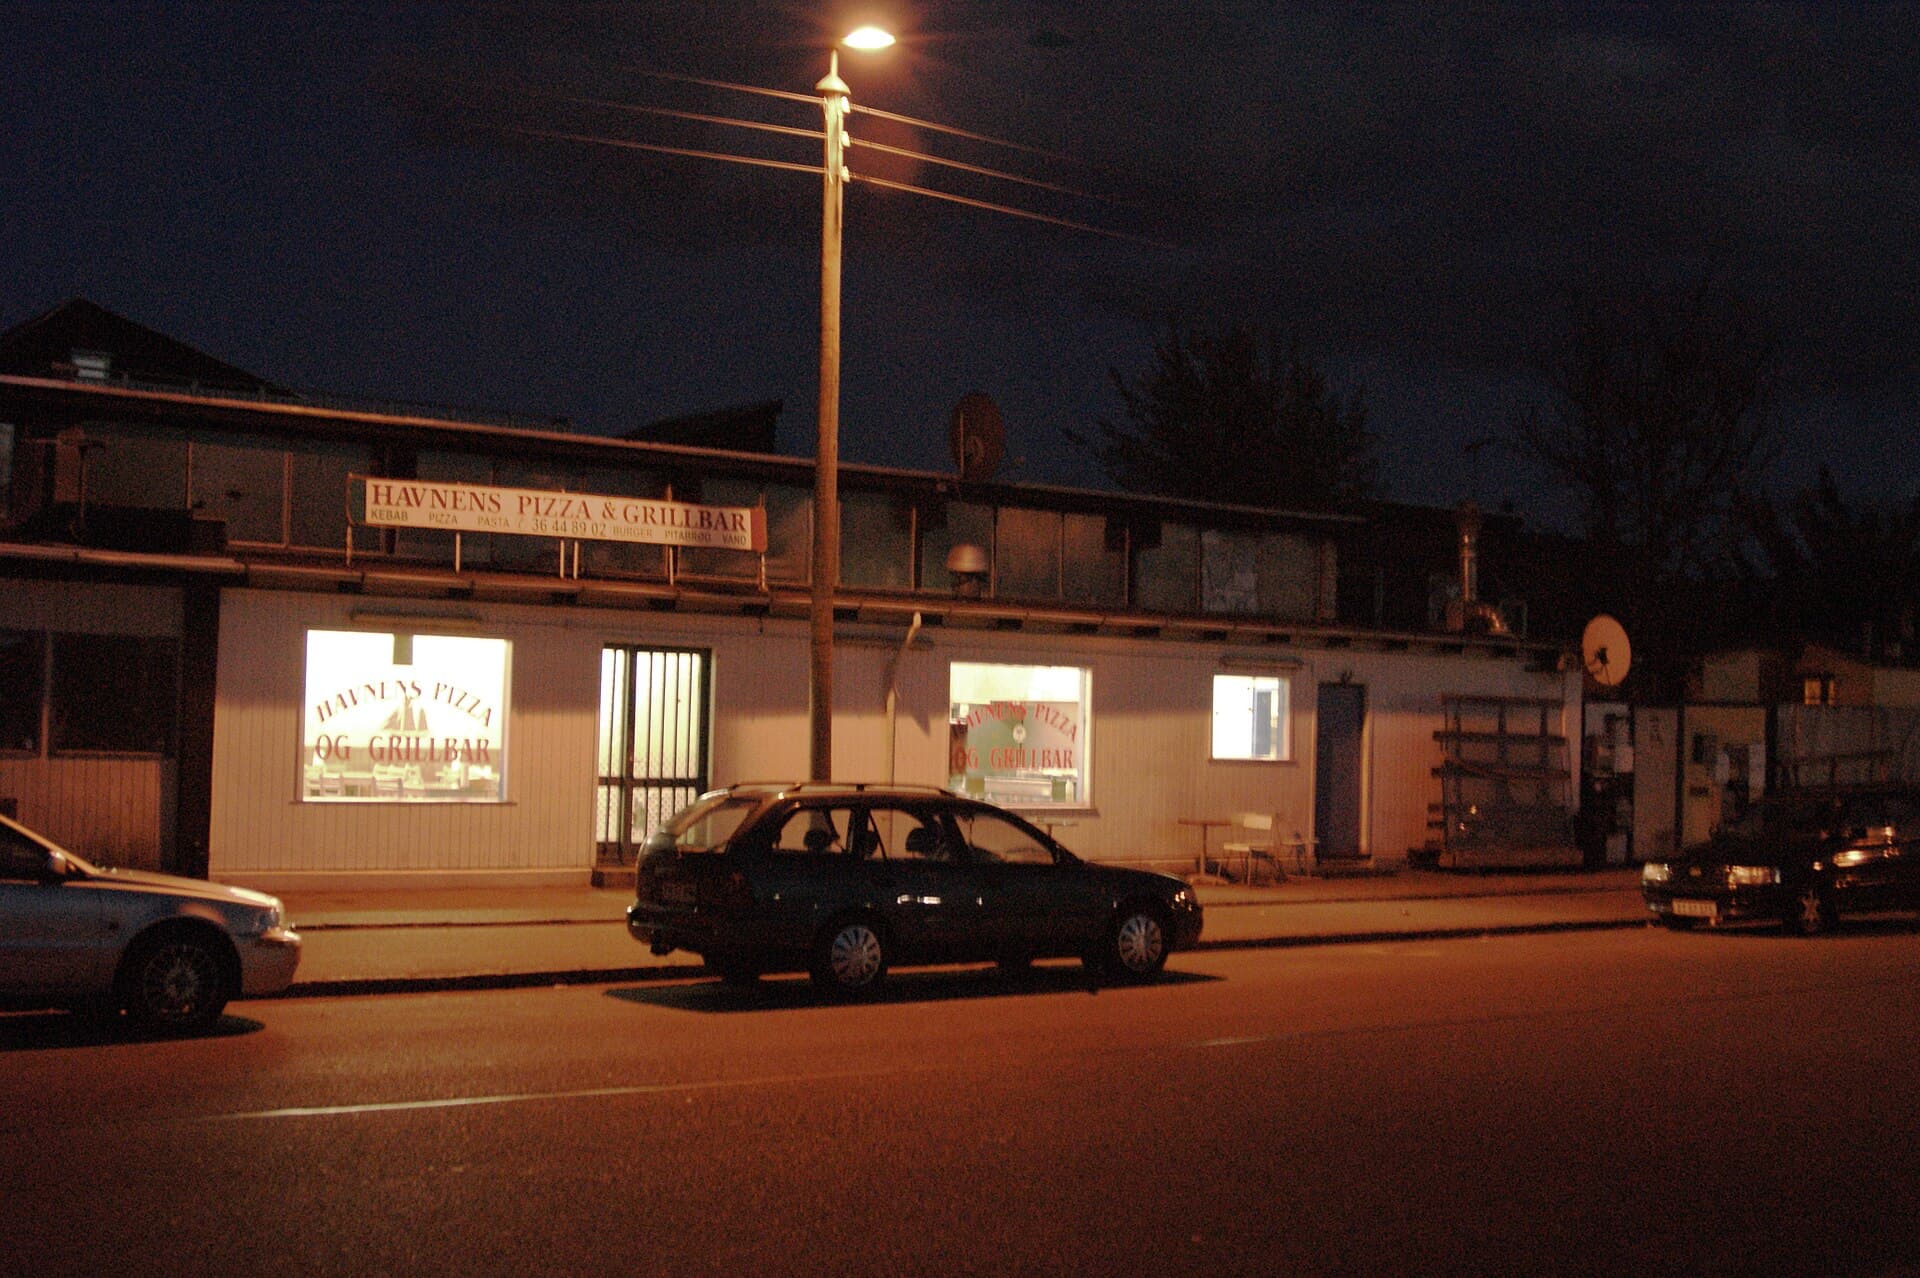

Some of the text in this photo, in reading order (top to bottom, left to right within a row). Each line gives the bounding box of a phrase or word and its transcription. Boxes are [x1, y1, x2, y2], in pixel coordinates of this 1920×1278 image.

[371, 509, 408, 521] KEBAB
[429, 511, 458, 526] PIZZA
[477, 516, 510, 528] PASTA
[532, 519, 547, 532] 36
[552, 519, 567, 533] 44
[591, 522, 606, 536] 02
[372, 484, 746, 532] HAVNENS PIZZA & GRILLBAR
[317, 680, 492, 728] HAVNENS PIZZA
[1034, 703, 1078, 743] PIZZA
[316, 733, 490, 763] OG GRILLBAR
[990, 746, 1073, 769] GRILLBAR
